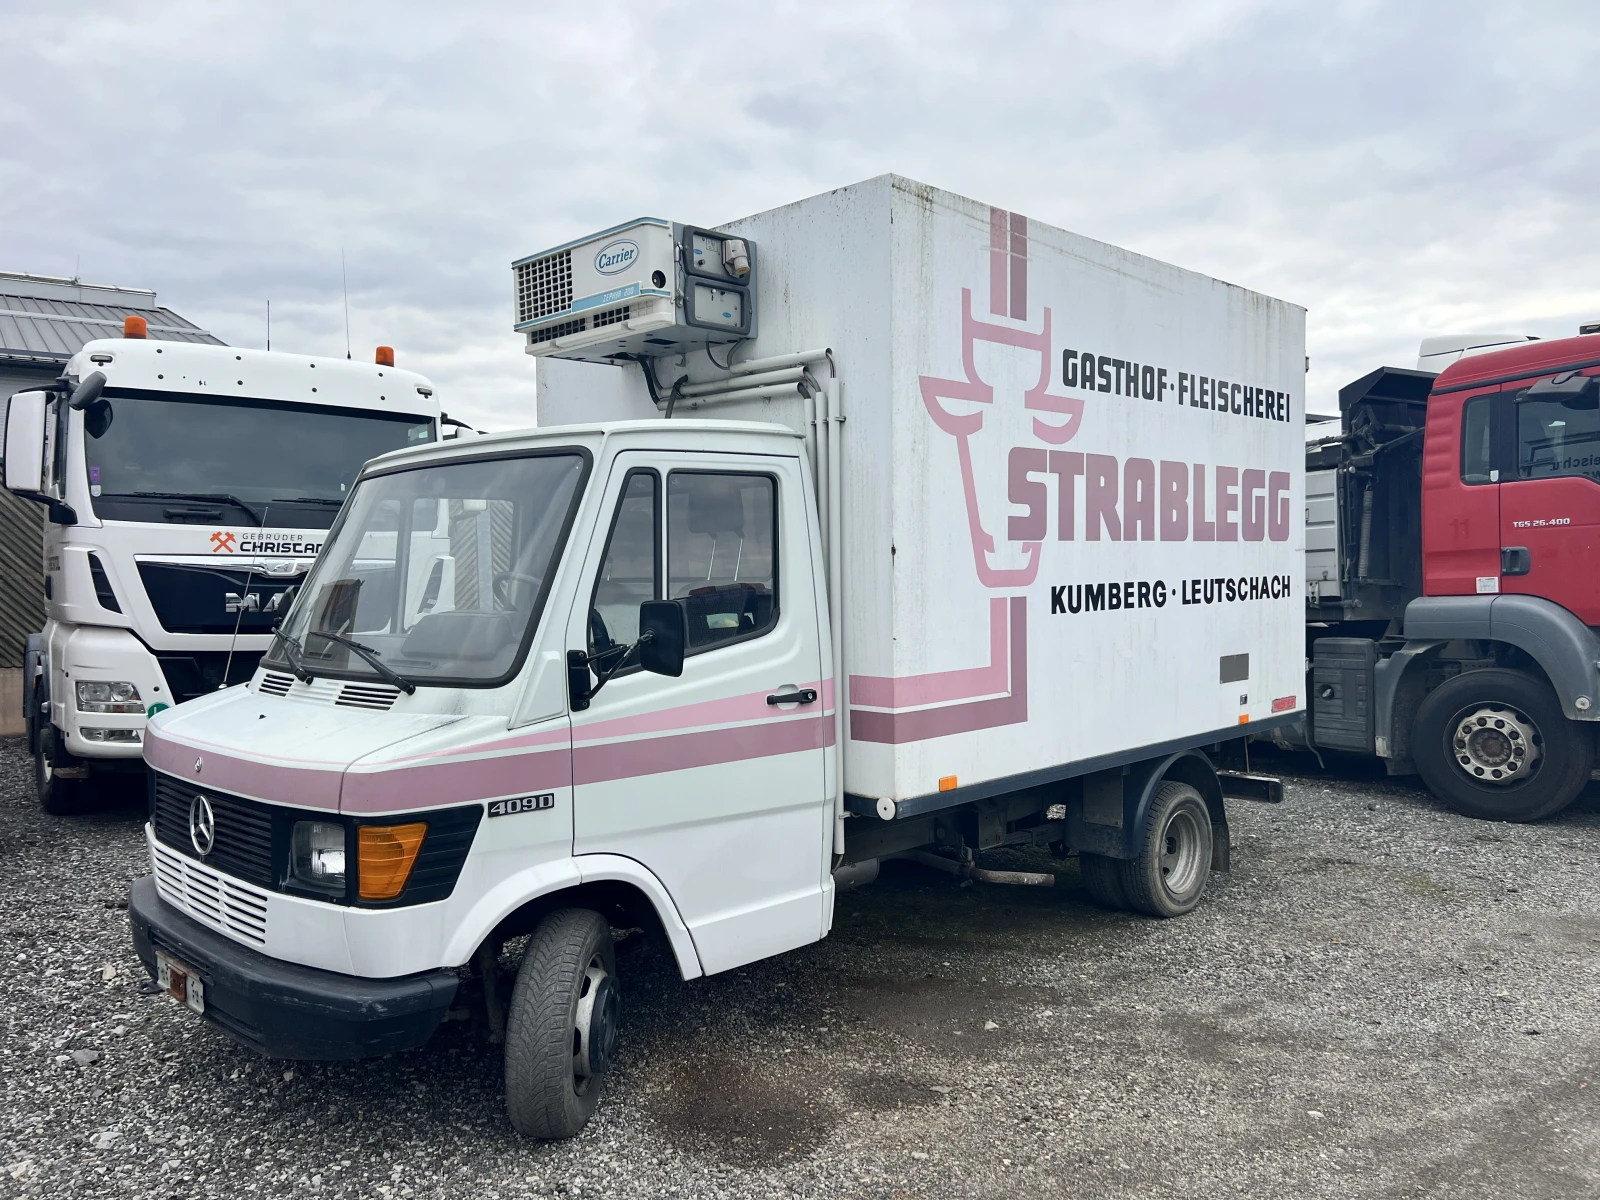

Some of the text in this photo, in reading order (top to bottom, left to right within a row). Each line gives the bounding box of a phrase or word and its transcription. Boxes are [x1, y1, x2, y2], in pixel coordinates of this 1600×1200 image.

[598, 247, 635, 270] Carrier
[1062, 348, 1290, 423] GASTHOF FLEISCHEREI
[1007, 446, 1291, 542] STRABLEGG
[1512, 517, 1571, 528] TGS 26.400
[242, 532, 303, 542] GEBRÜDER
[1050, 575, 1291, 615] KUMBERG LEUTSCHACH
[490, 794, 554, 815] 409D
